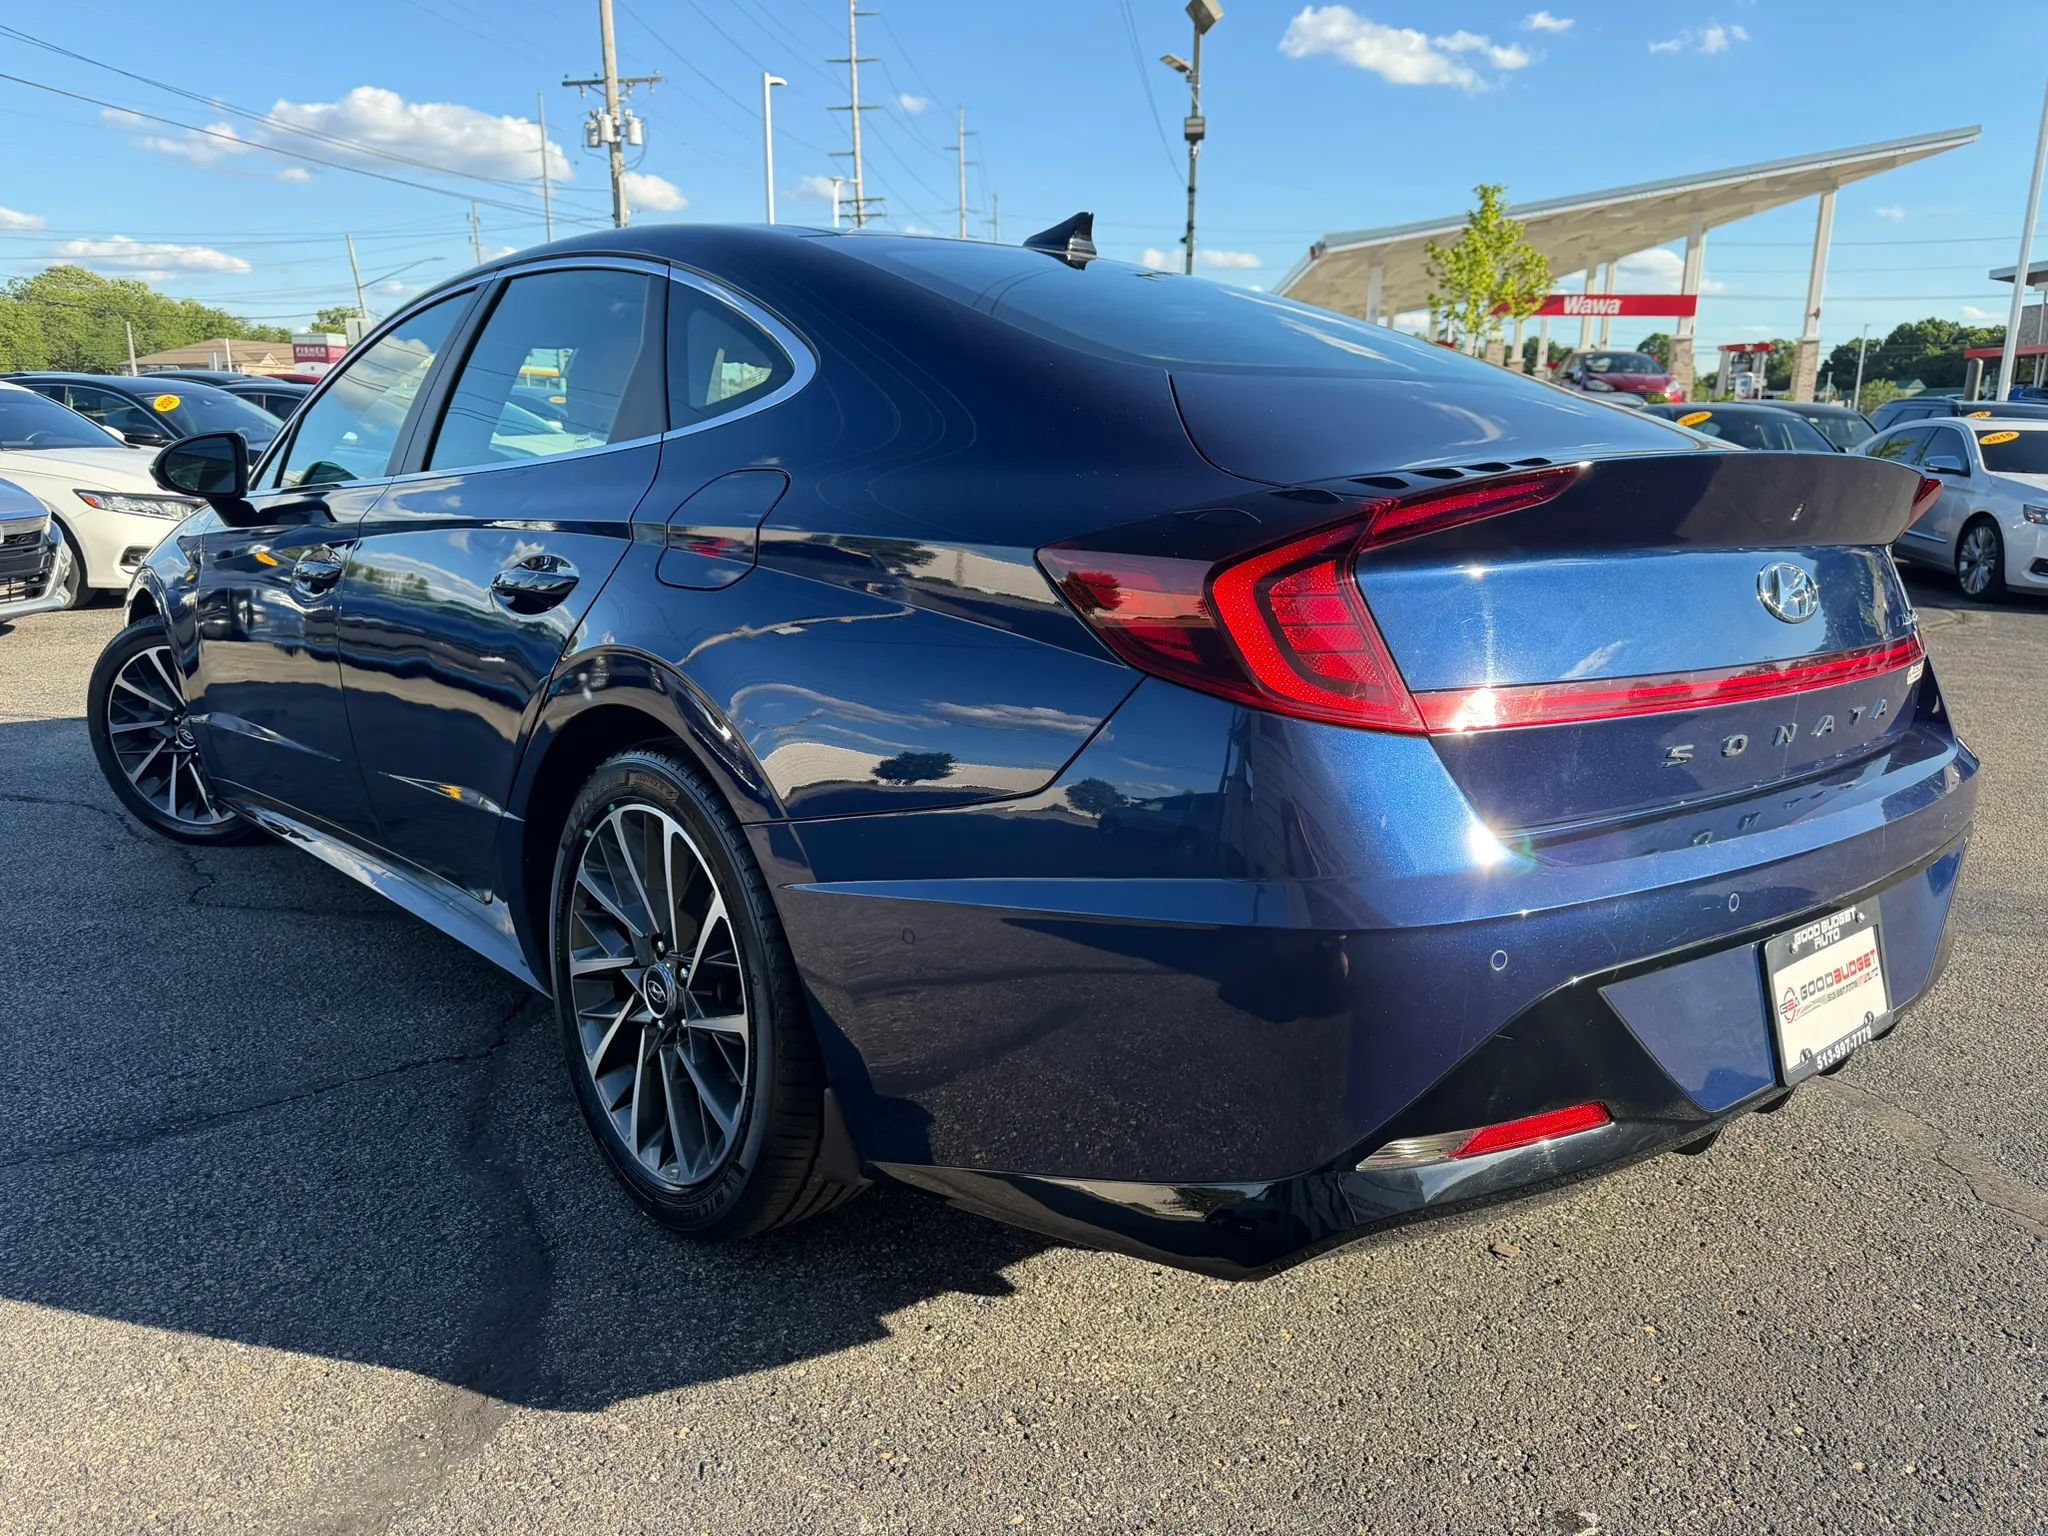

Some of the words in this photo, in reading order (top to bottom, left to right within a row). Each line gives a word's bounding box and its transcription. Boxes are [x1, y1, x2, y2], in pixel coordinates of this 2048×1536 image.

[1564, 295, 1622, 315] Wawa
[296, 346, 326, 354] FISHER
[1661, 698, 1888, 768] SONATA
[1794, 923, 1820, 946] GOOD
[1820, 905, 1856, 934] BUDGET
[1814, 928, 1840, 950] AUTO
